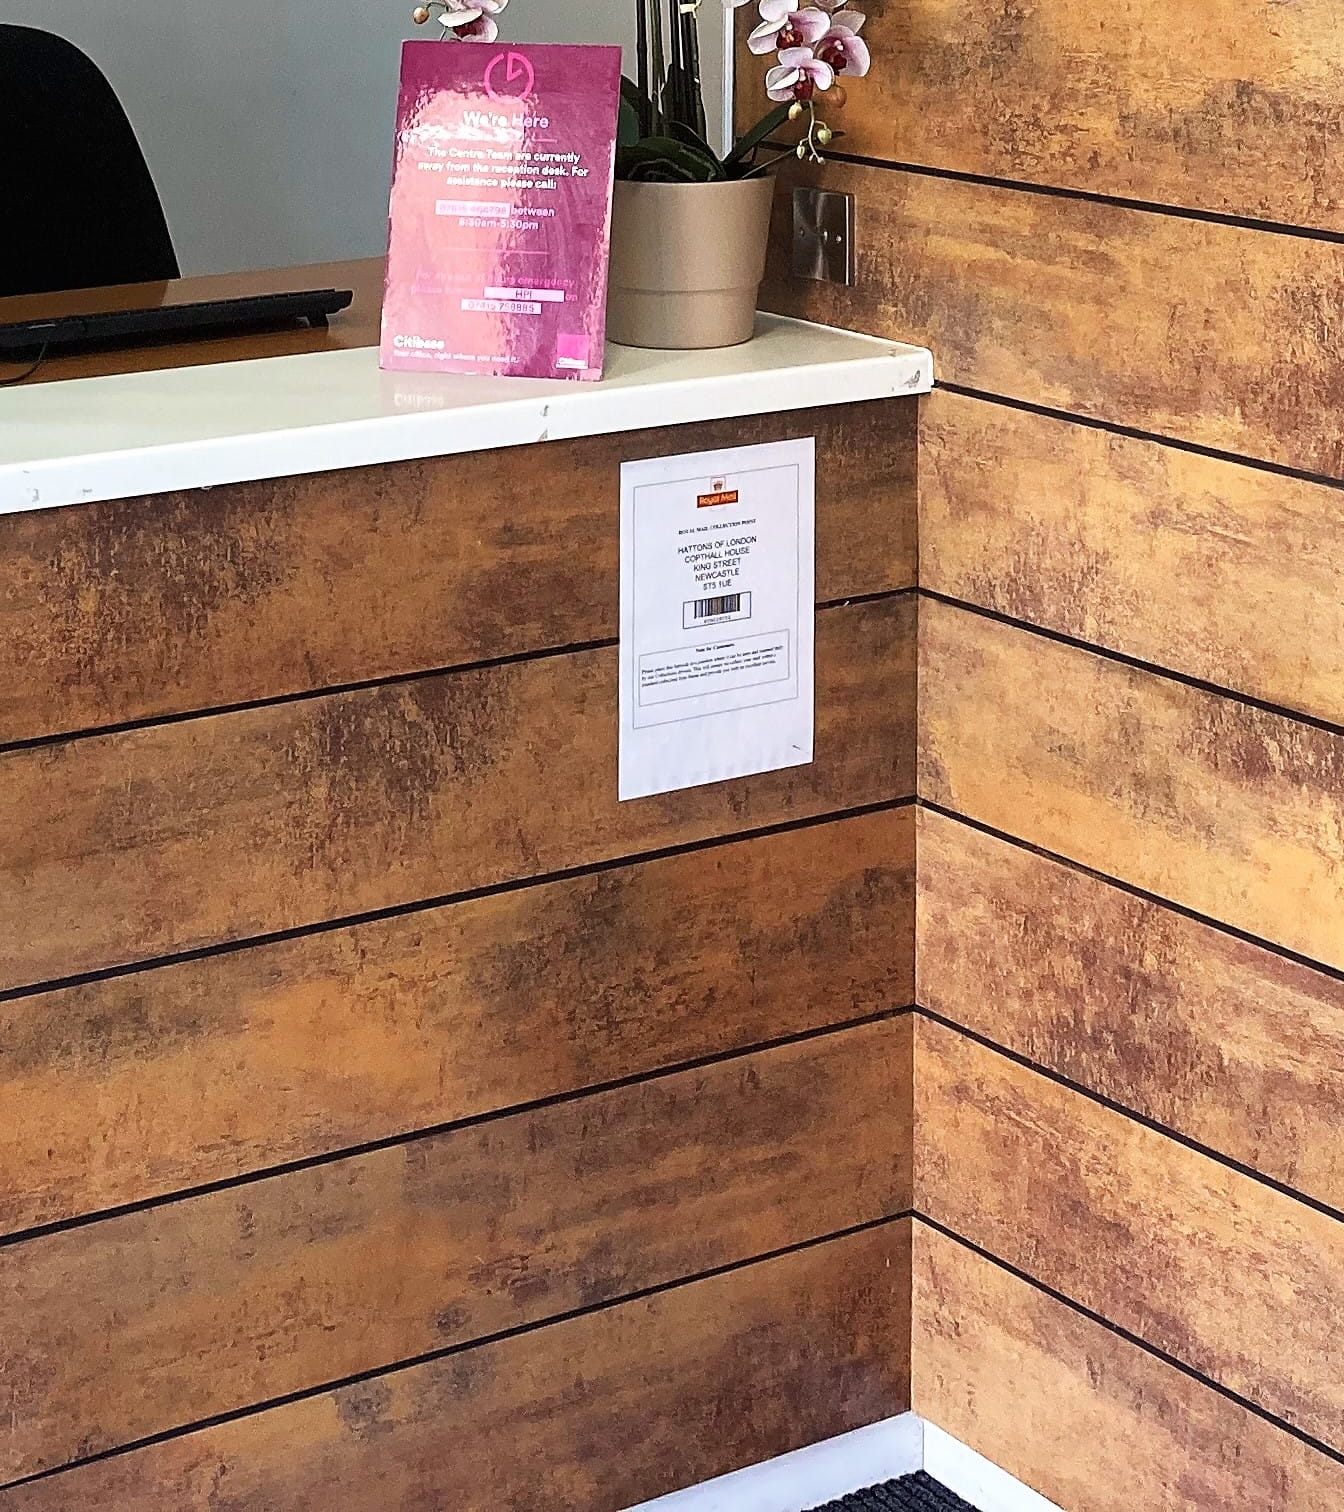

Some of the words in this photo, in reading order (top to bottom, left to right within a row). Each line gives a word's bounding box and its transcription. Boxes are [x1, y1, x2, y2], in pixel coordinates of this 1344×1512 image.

[533, 151, 580, 165] currently
[446, 160, 470, 172] from
[491, 162, 540, 177] reception
[500, 178, 533, 190] please
[510, 204, 555, 217] between
[677, 541, 713, 554] HATTONS
[714, 539, 725, 549] OF
[726, 535, 757, 548] LONDON
[724, 545, 751, 557] HOUSE
[693, 561, 712, 572] KING
[713, 557, 741, 569] STREET
[695, 567, 740, 582] NEWCASTLE
